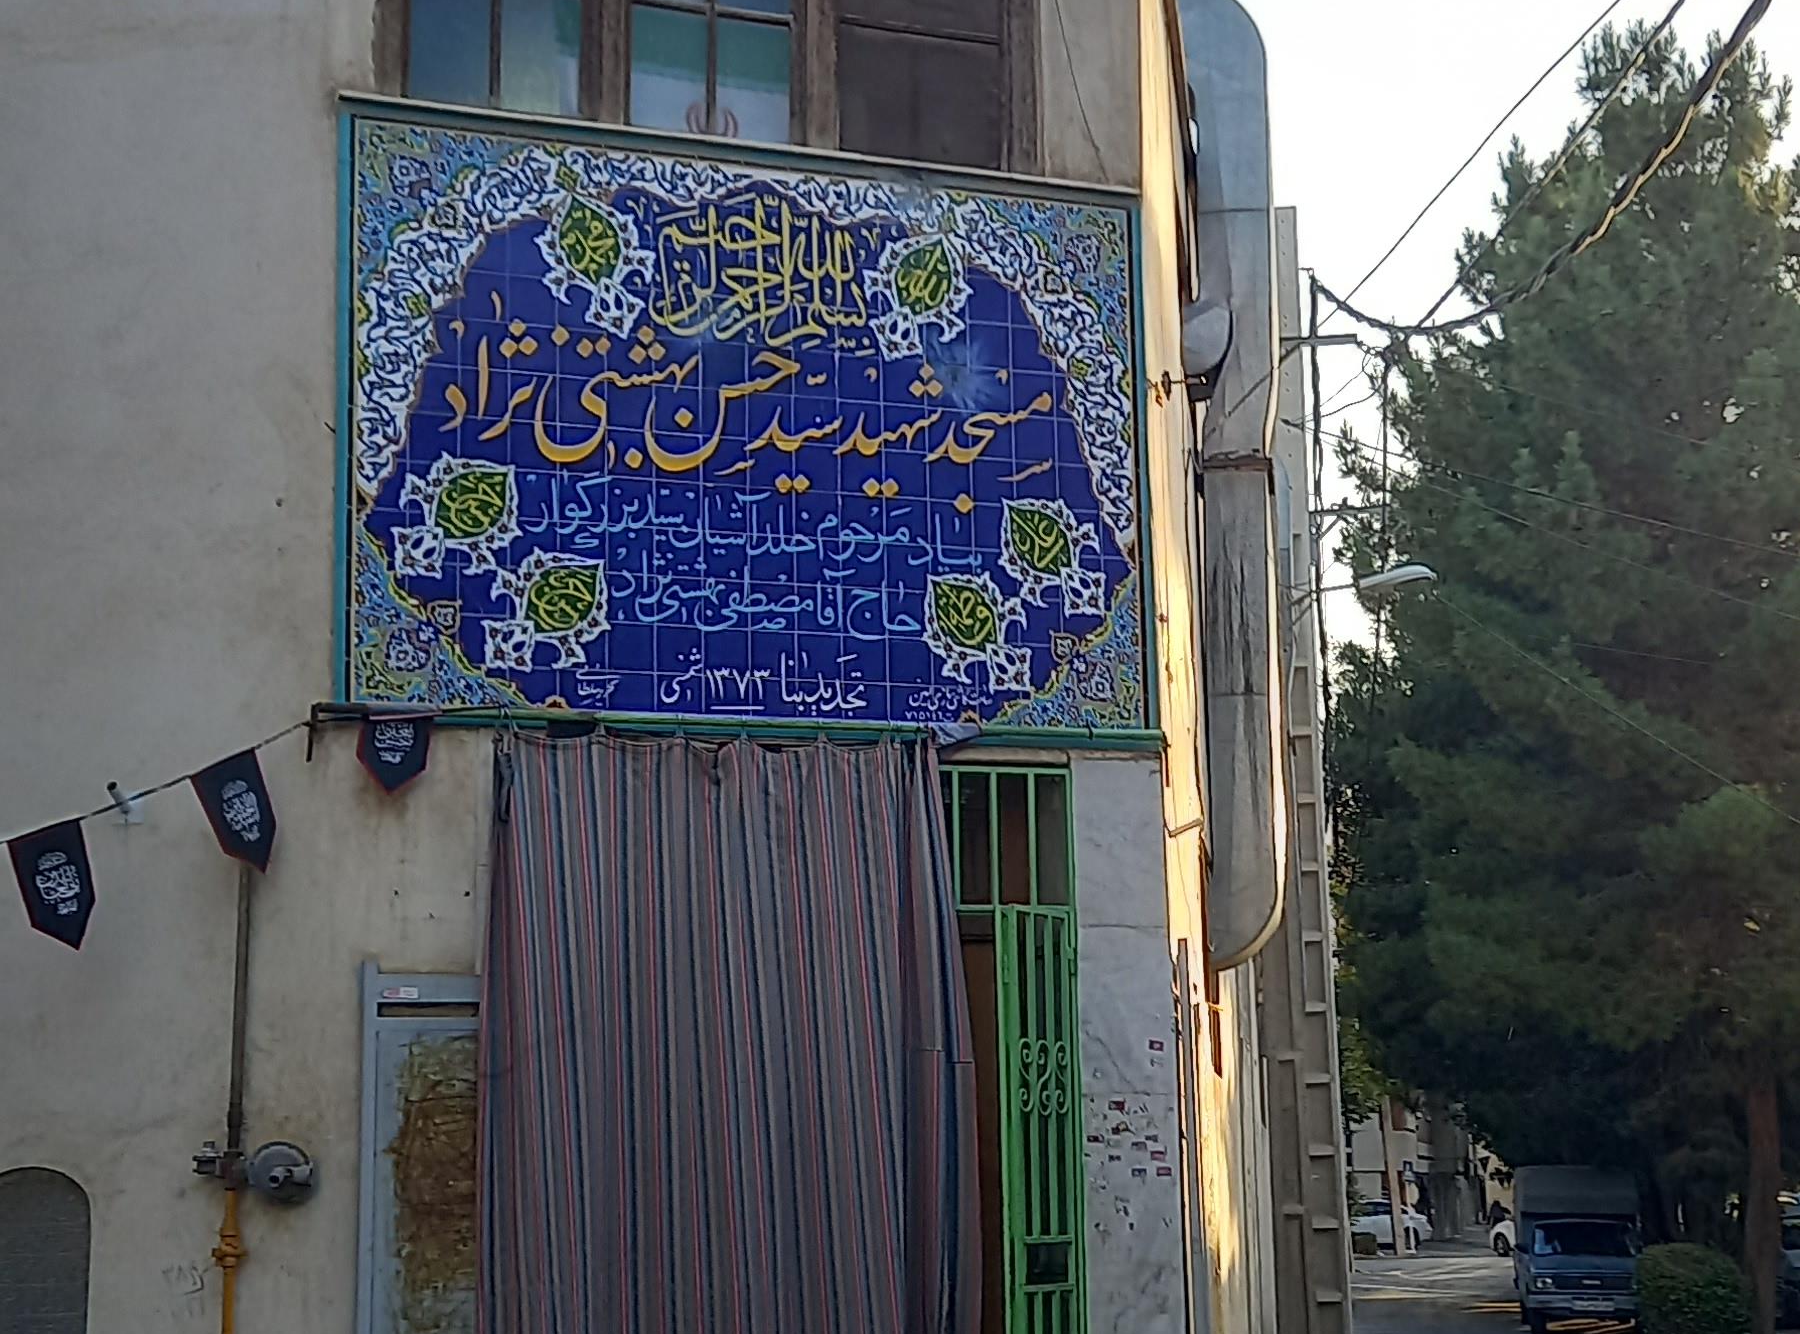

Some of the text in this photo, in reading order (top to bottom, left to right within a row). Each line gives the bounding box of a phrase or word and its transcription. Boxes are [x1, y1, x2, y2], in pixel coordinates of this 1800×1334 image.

[438, 318, 570, 442] نژاد
[534, 324, 702, 470] بهشتی
[643, 350, 802, 473] حسن
[832, 362, 944, 498] شهید
[922, 390, 1053, 514] مسجد
[610, 549, 922, 641] حاج آقا مصطفی بهشتی نژاد
